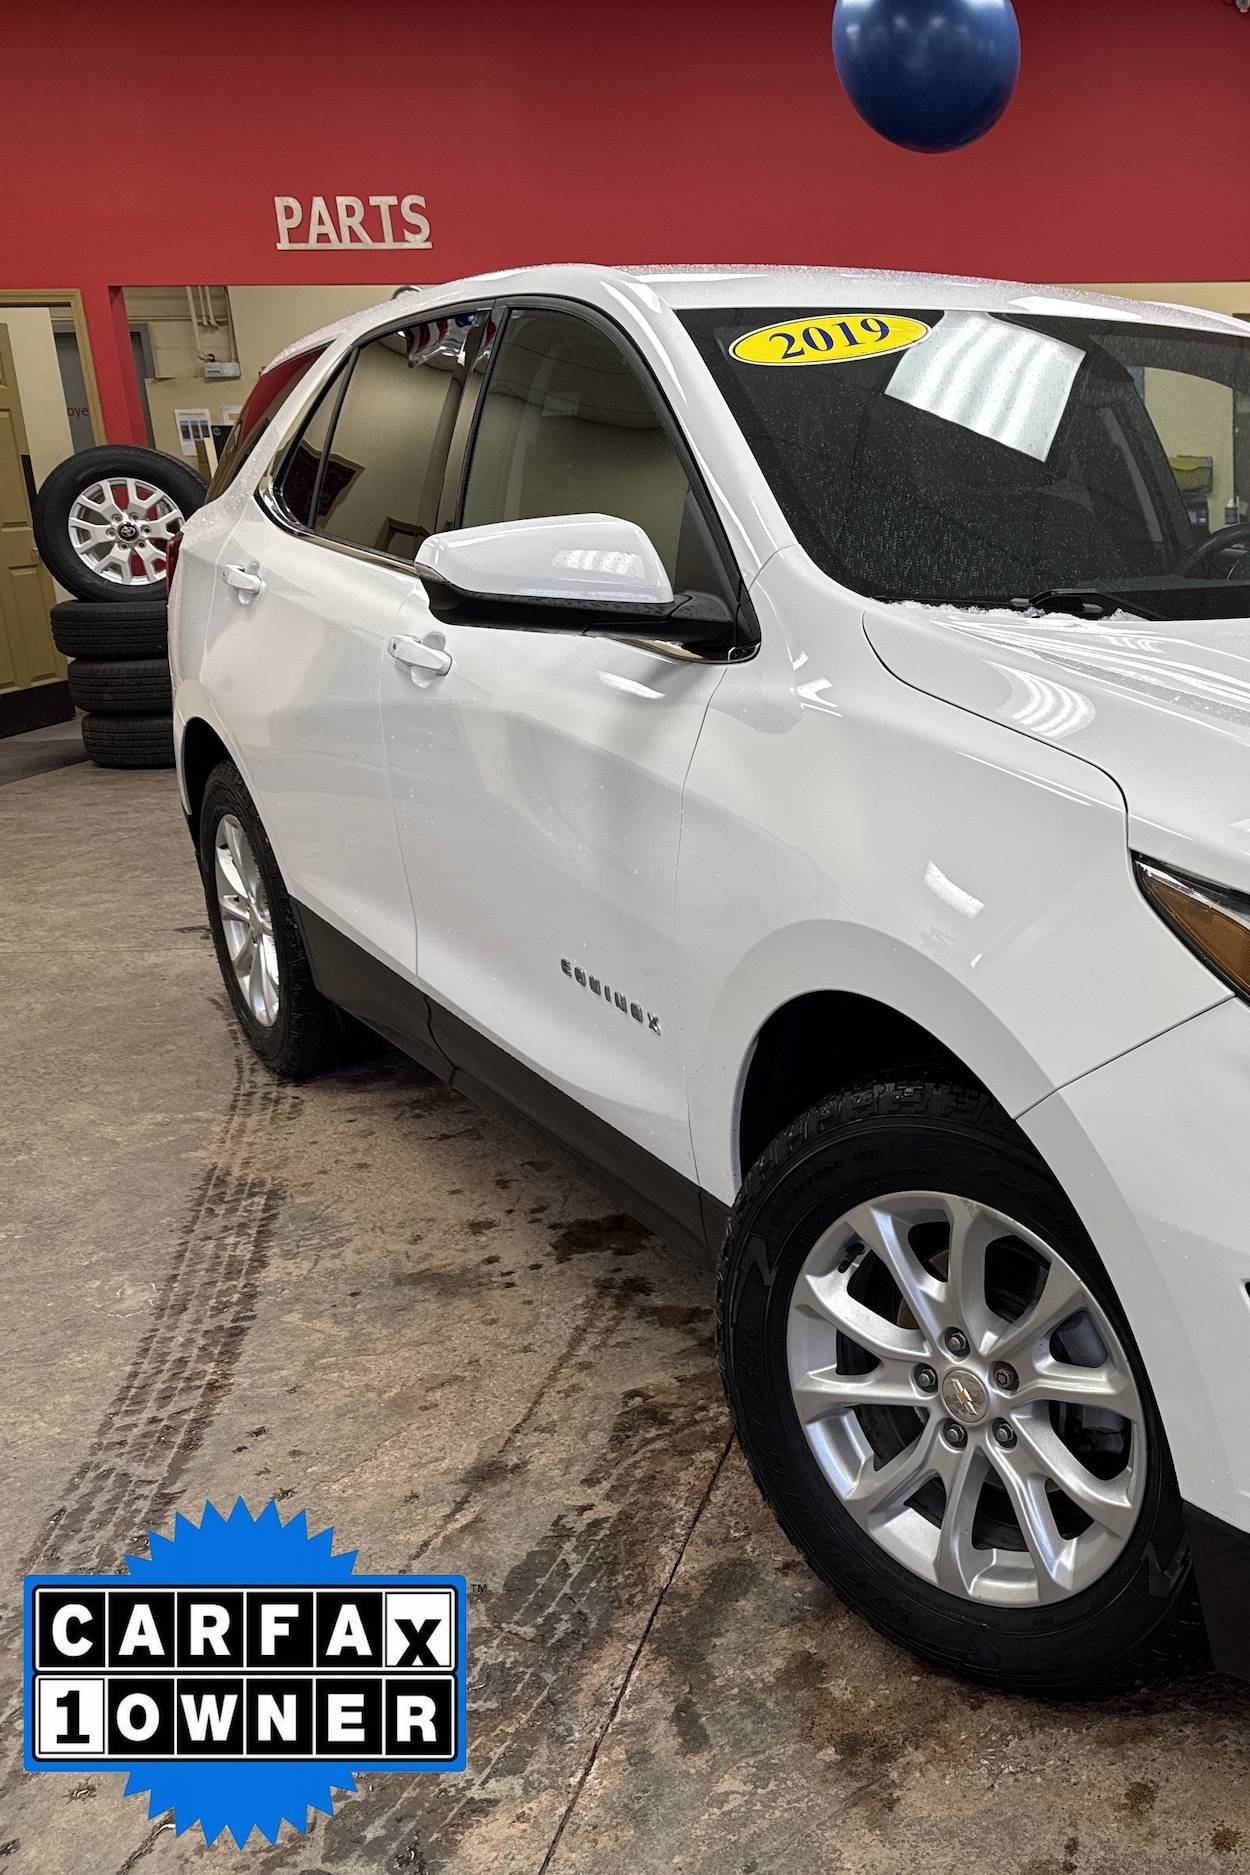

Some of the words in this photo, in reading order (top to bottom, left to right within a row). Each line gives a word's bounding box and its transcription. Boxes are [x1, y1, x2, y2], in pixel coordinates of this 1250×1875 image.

[274, 195, 432, 249] PARTS
[769, 318, 890, 360] 2019
[560, 958, 661, 1036] EQUINOX
